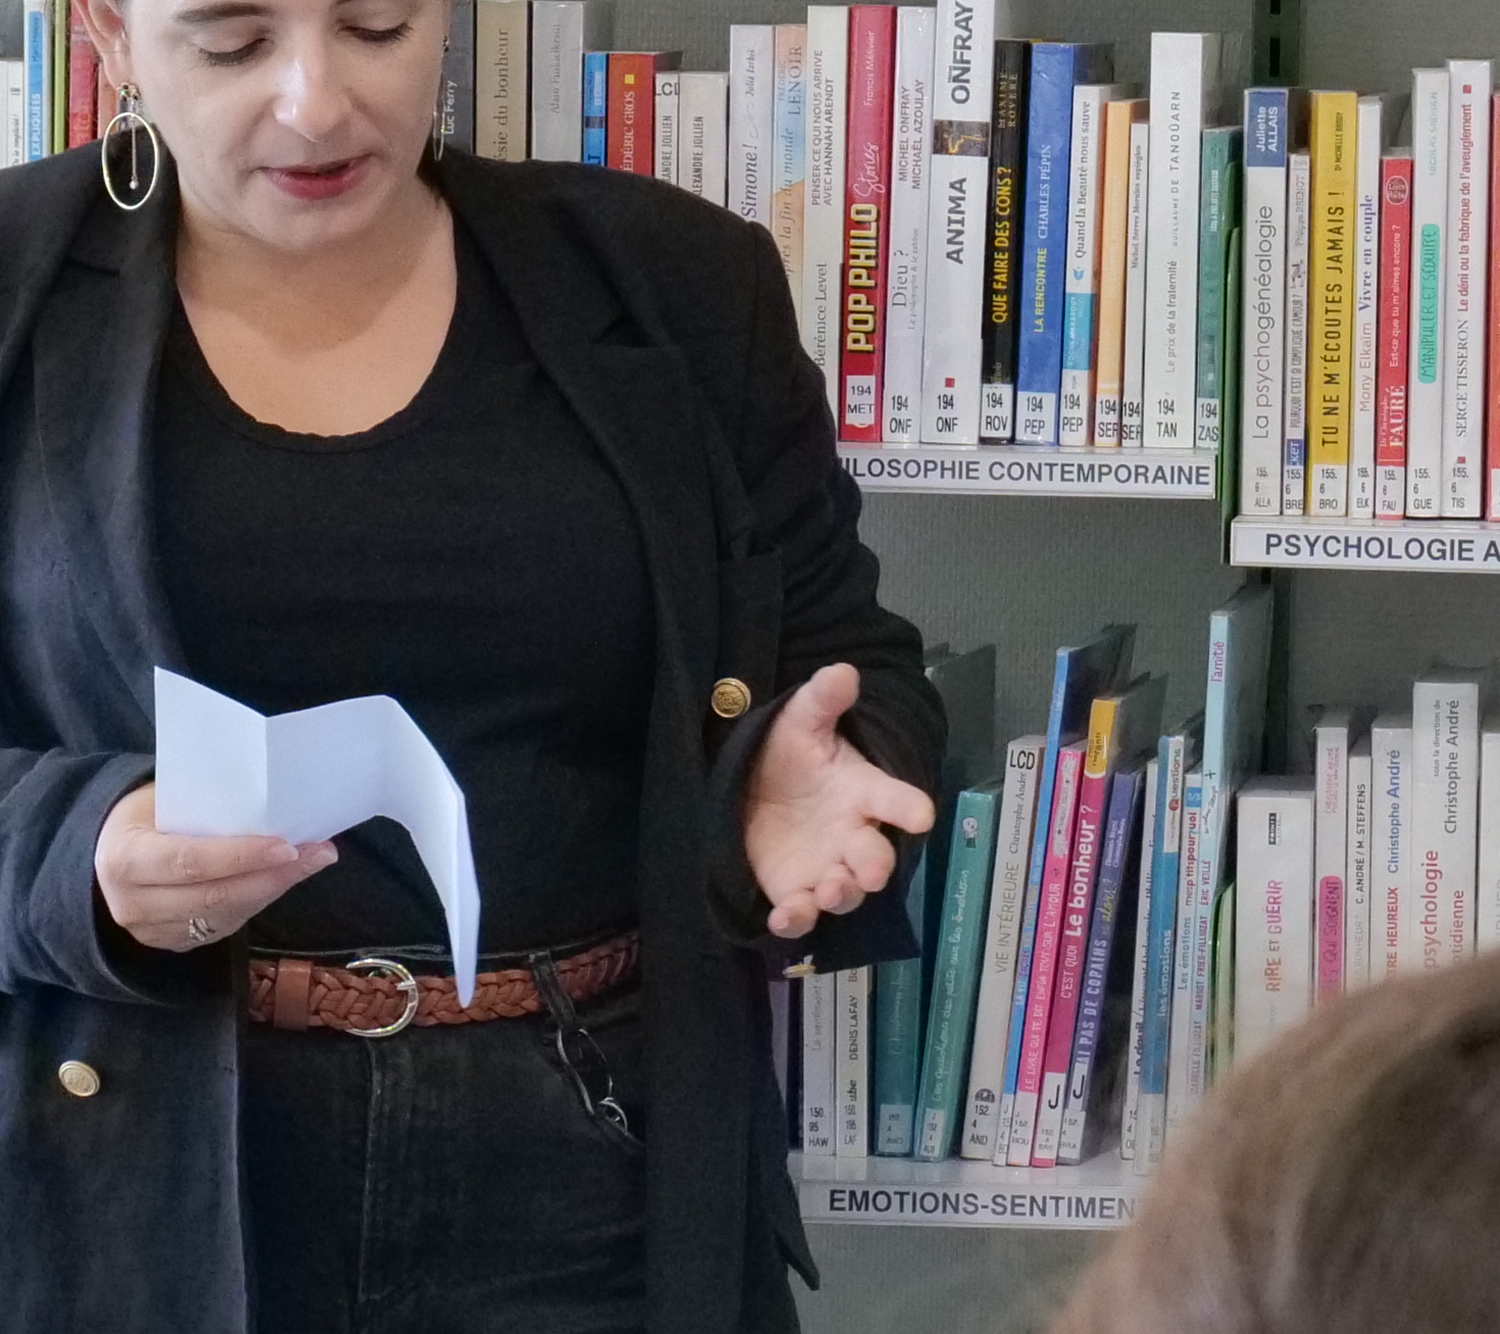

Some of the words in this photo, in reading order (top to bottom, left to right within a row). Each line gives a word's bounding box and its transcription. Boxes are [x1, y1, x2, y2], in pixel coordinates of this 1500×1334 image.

[950, 0, 975, 105] ONFRAY
[996, 179, 1012, 220] CONS
[946, 177, 967, 265] ANIMA
[995, 222, 1011, 245] DES
[1327, 205, 1345, 275] JAMAIS
[848, 203, 879, 287] PHILO
[994, 247, 1011, 290] FAIRE
[847, 293, 876, 353] POP
[993, 293, 1010, 324] QUE
[1255, 205, 1276, 409] psychogénéalogie
[1324, 282, 1342, 387] M'ÉCOUTES
[986, 393, 1003, 408] 194
[1323, 394, 1340, 418] NE
[986, 415, 1008, 432] ROV
[1252, 414, 1269, 440] La
[1322, 422, 1339, 447] TU
[841, 456, 980, 482] ILOSOPHIE
[989, 461, 1211, 487] CONTEMPORAINE
[1264, 535, 1474, 562] PSYCHOLOGIE
[1446, 700, 1460, 747] André
[1008, 749, 1035, 770] LCD
[1444, 751, 1460, 834] Christophe
[1067, 822, 1097, 909] bonheur
[1065, 912, 1083, 937] Le
